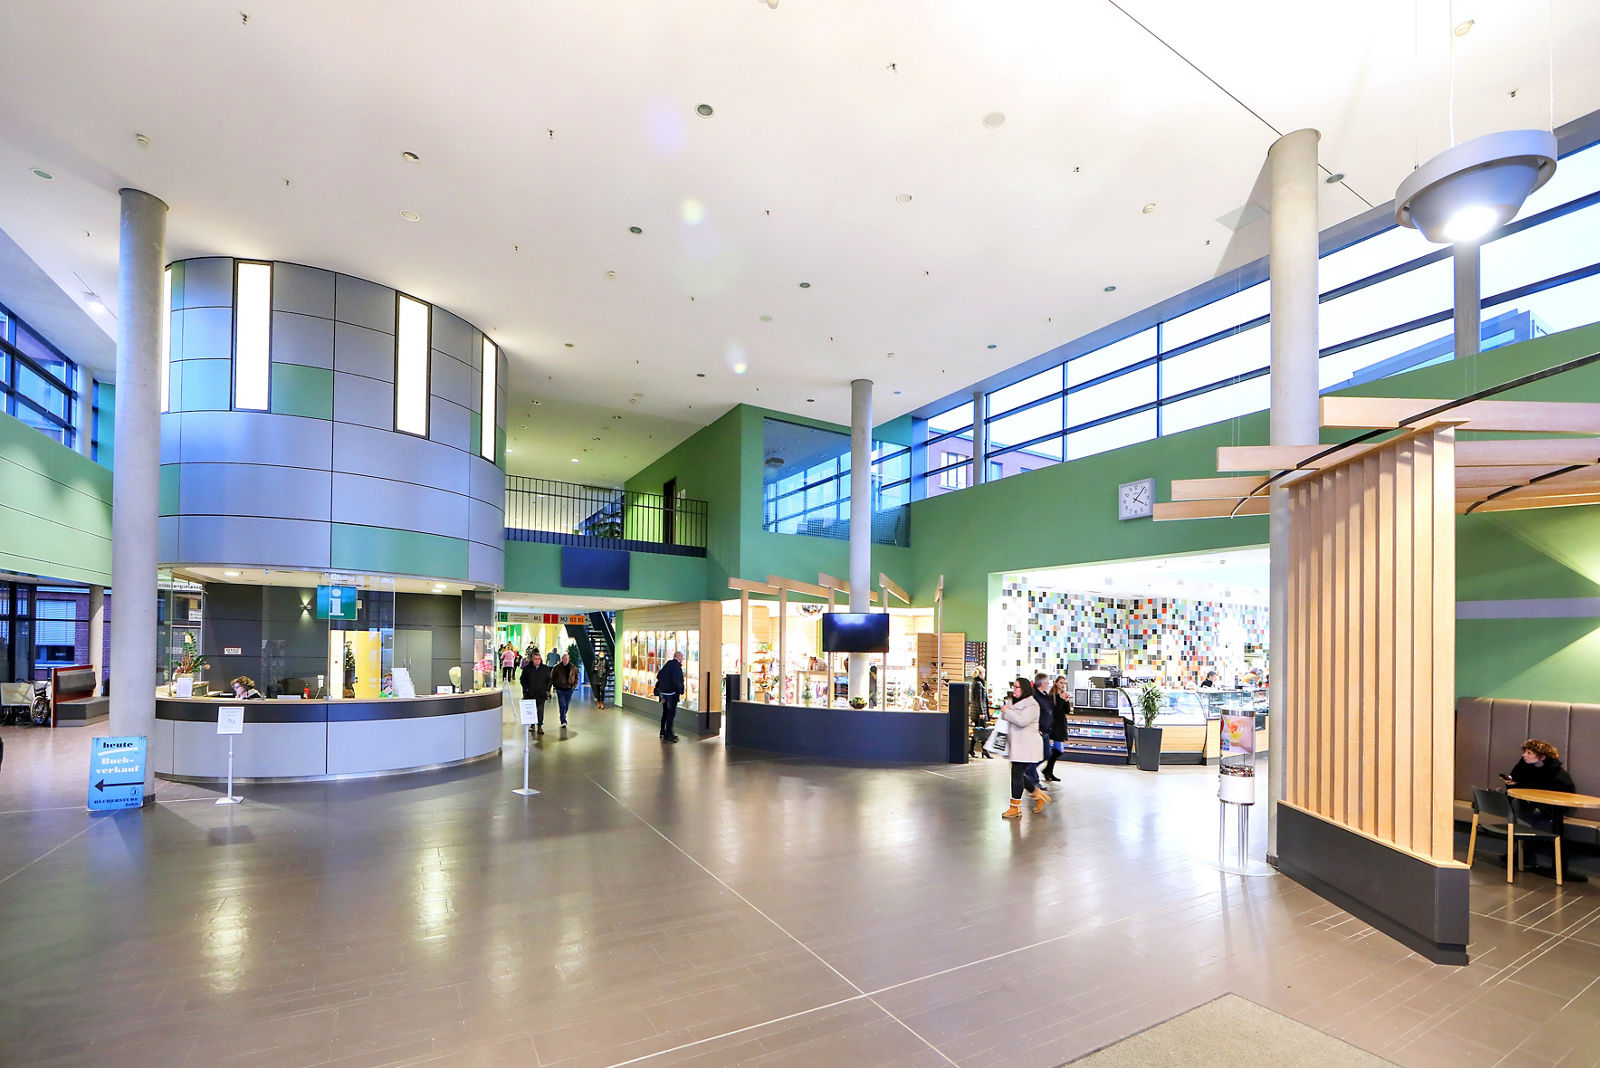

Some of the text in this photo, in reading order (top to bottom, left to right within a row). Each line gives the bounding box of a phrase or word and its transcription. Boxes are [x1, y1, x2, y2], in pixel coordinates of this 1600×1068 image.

[102, 741, 133, 749] heute
[101, 757, 134, 765] Buch-
[95, 765, 139, 774] verkauf
